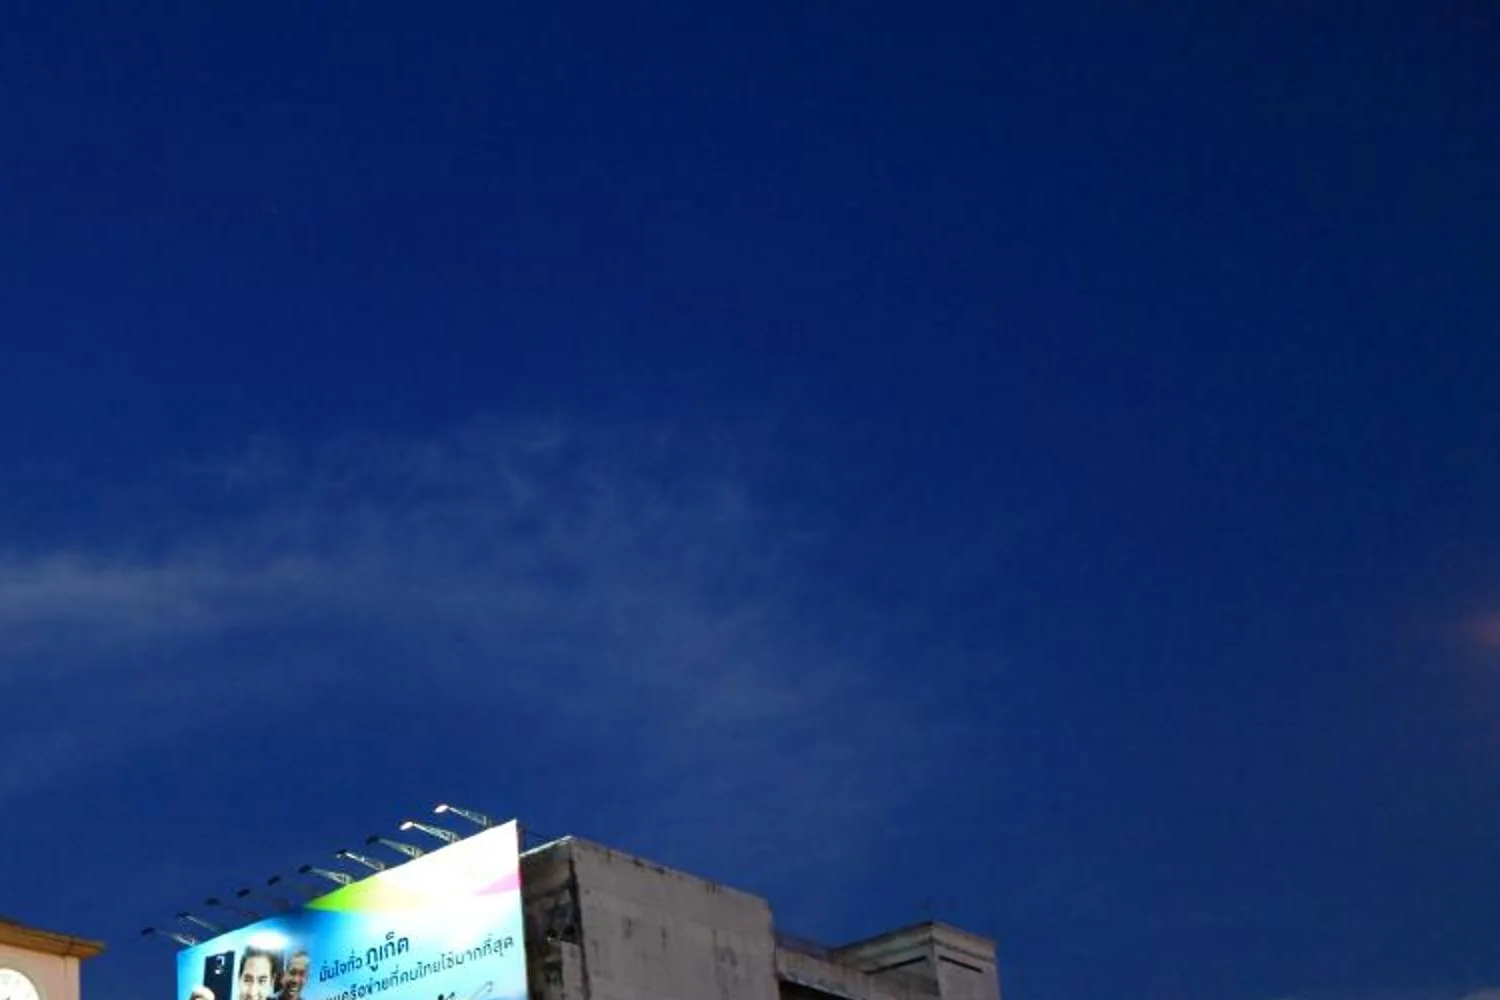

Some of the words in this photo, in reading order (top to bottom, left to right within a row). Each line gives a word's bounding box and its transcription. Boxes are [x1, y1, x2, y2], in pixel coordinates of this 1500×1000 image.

[319, 950, 363, 982] มั่นใจทั่ว
[365, 931, 409, 972] ภูเก็ต
